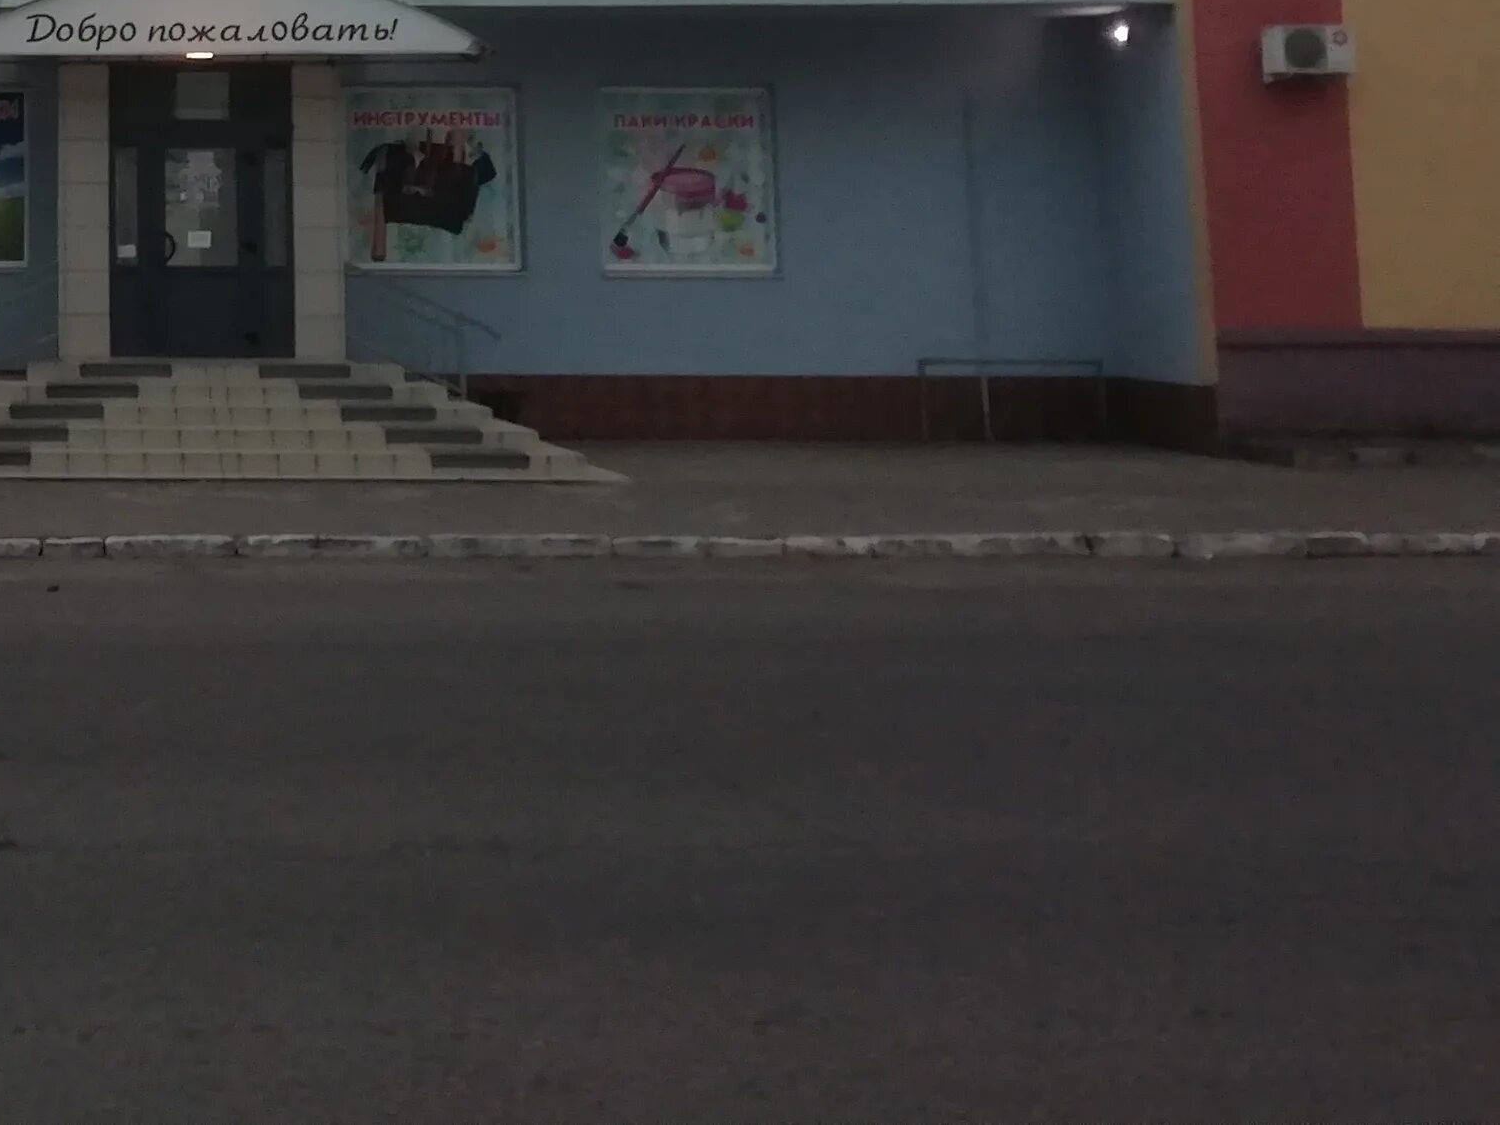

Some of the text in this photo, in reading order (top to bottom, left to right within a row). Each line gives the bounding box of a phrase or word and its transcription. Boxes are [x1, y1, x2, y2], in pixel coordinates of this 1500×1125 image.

[25, 12, 399, 50] Добро пожаловать!
[353, 110, 501, 127] ИНСТРУМЕНТЫ
[675, 113, 755, 129] КРАСКИ
